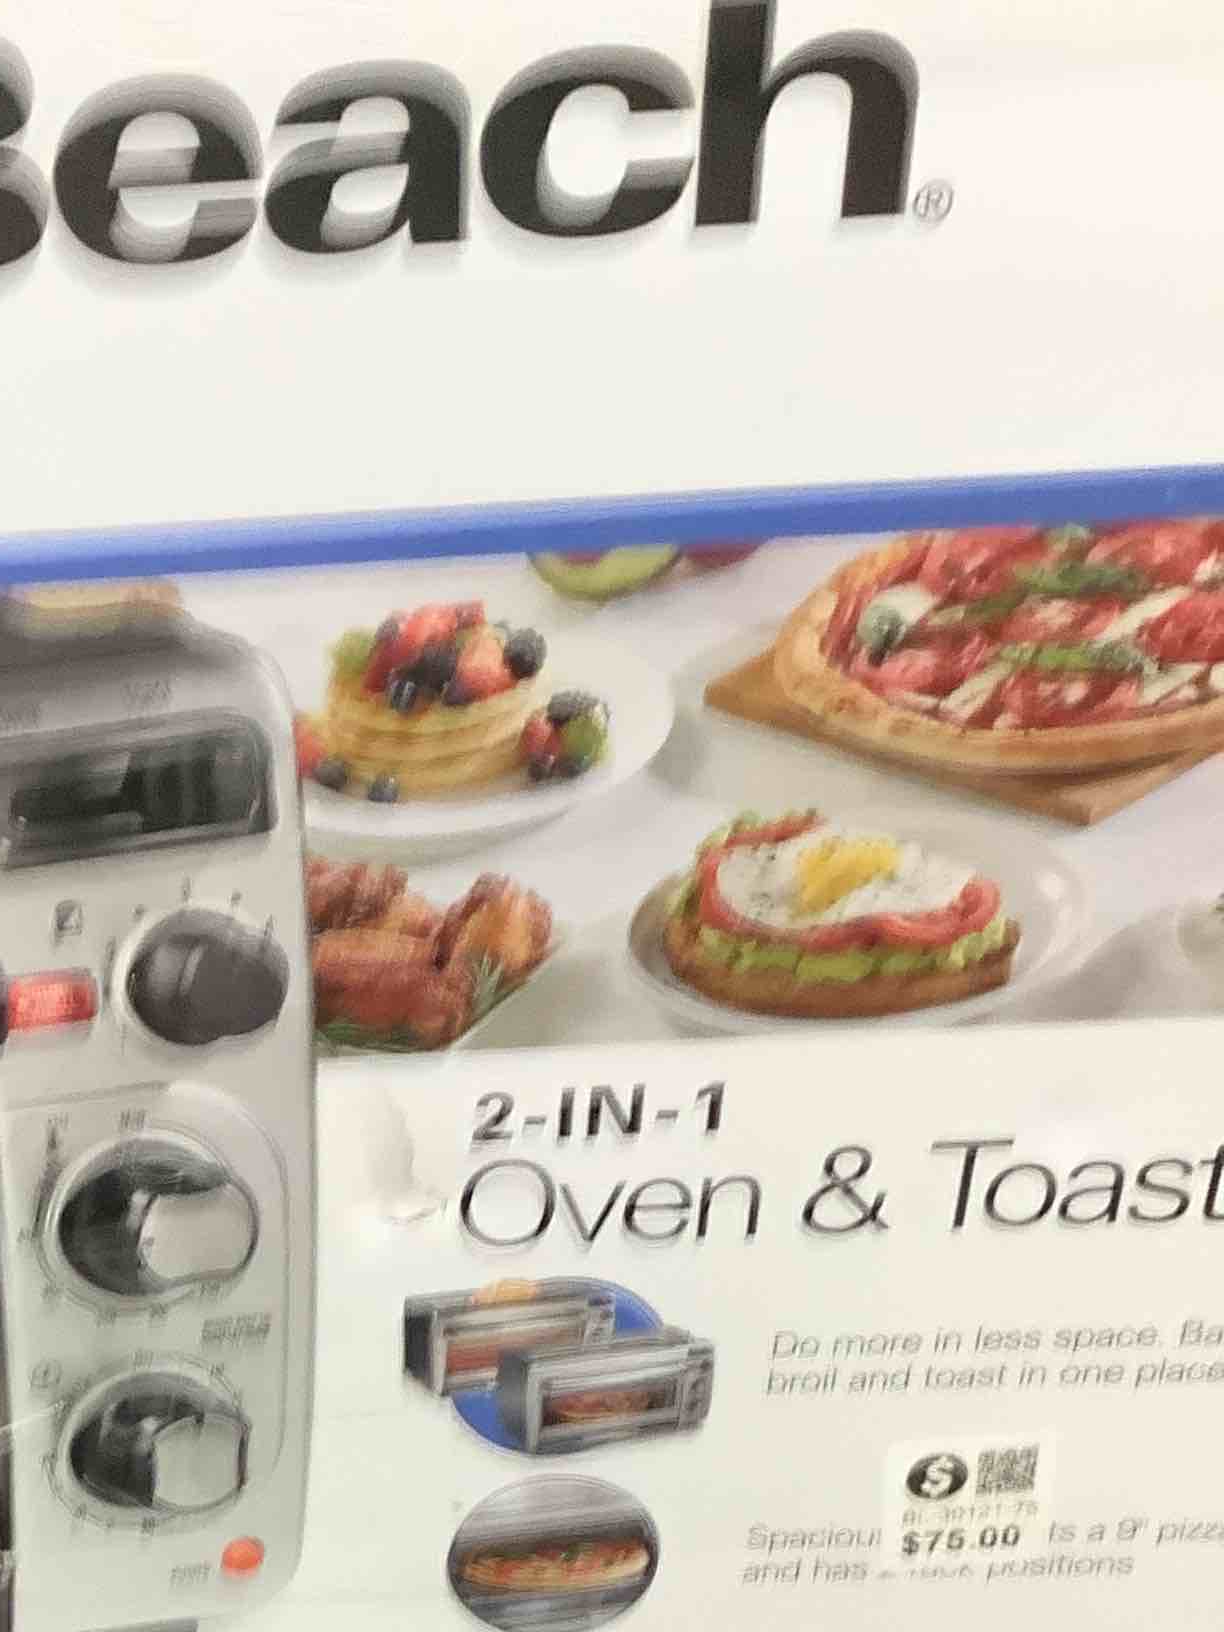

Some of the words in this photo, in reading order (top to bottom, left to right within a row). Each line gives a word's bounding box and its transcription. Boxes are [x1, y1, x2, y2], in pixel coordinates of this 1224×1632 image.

[472, 1081, 726, 1146] 2-IN-1
[459, 1157, 763, 1247] Oven
[801, 1144, 889, 1237] &
[932, 1136, 1224, 1238] Toast
[772, 1329, 820, 1359] Do
[832, 1330, 922, 1359] more
[933, 1326, 962, 1354] in
[975, 1324, 1041, 1353] less
[1053, 1324, 1161, 1360] space.
[767, 1366, 838, 1396] broil
[848, 1363, 911, 1394] and
[924, 1361, 1007, 1391] toast
[1019, 1359, 1047, 1387] in
[1059, 1360, 1123, 1386] one
[746, 1522, 882, 1556] Spaciou
[743, 1559, 801, 1584] and
[812, 1556, 868, 1583] has
